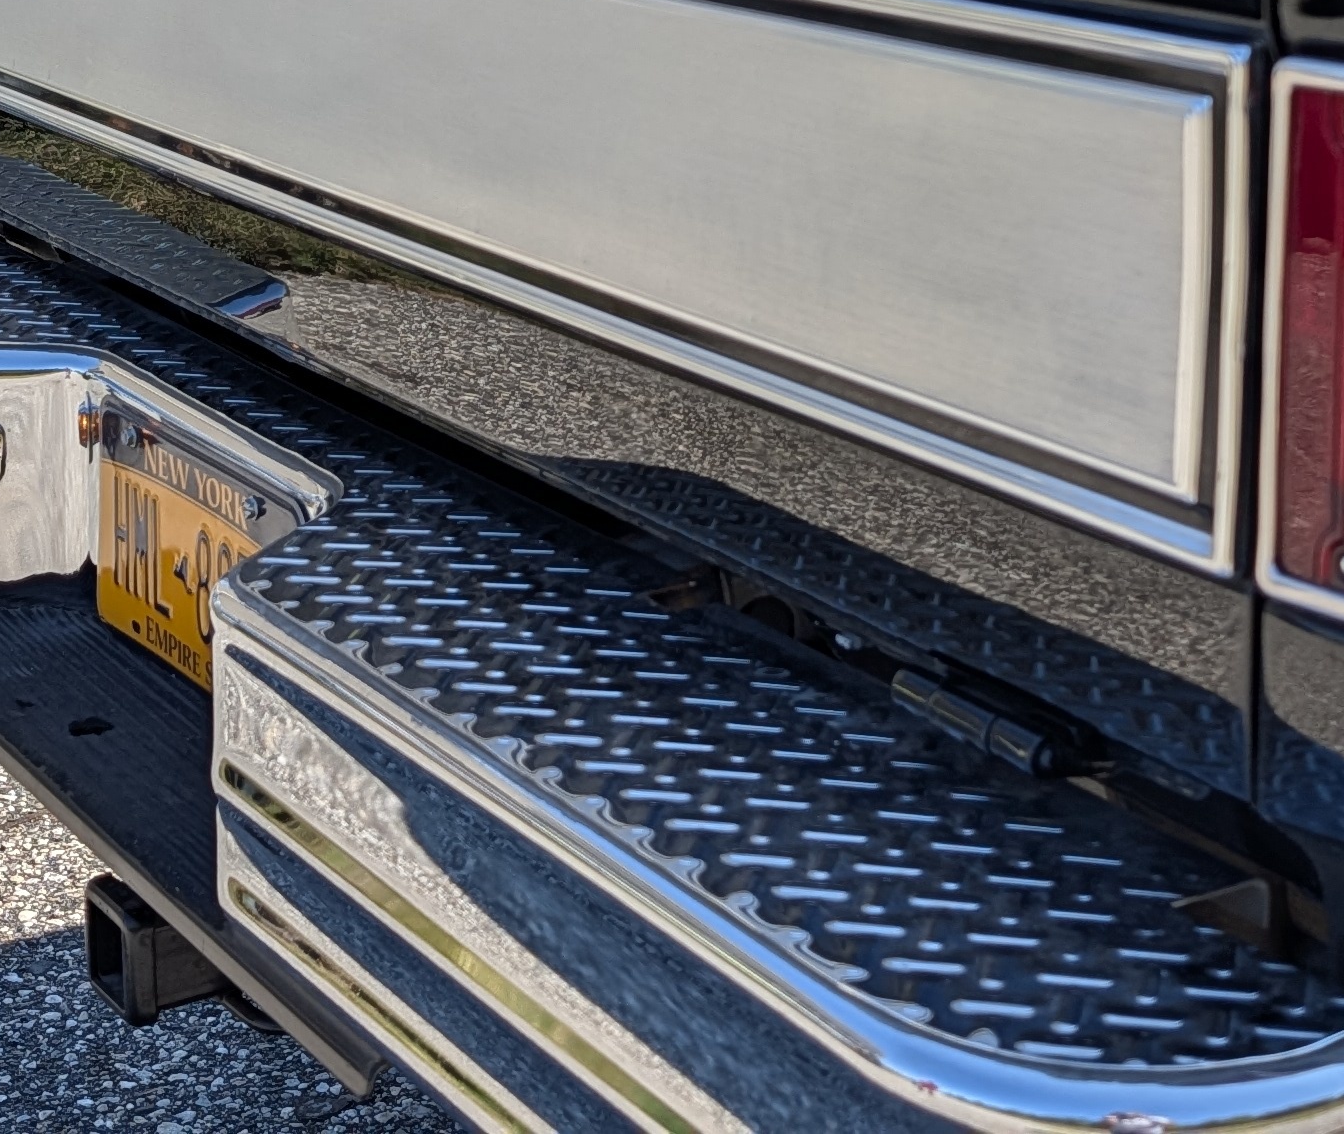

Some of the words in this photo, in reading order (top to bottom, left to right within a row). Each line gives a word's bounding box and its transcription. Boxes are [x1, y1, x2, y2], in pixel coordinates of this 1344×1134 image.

[142, 439, 190, 491] NEW
[193, 467, 248, 532] YORK
[145, 617, 202, 679] EMPIRE
